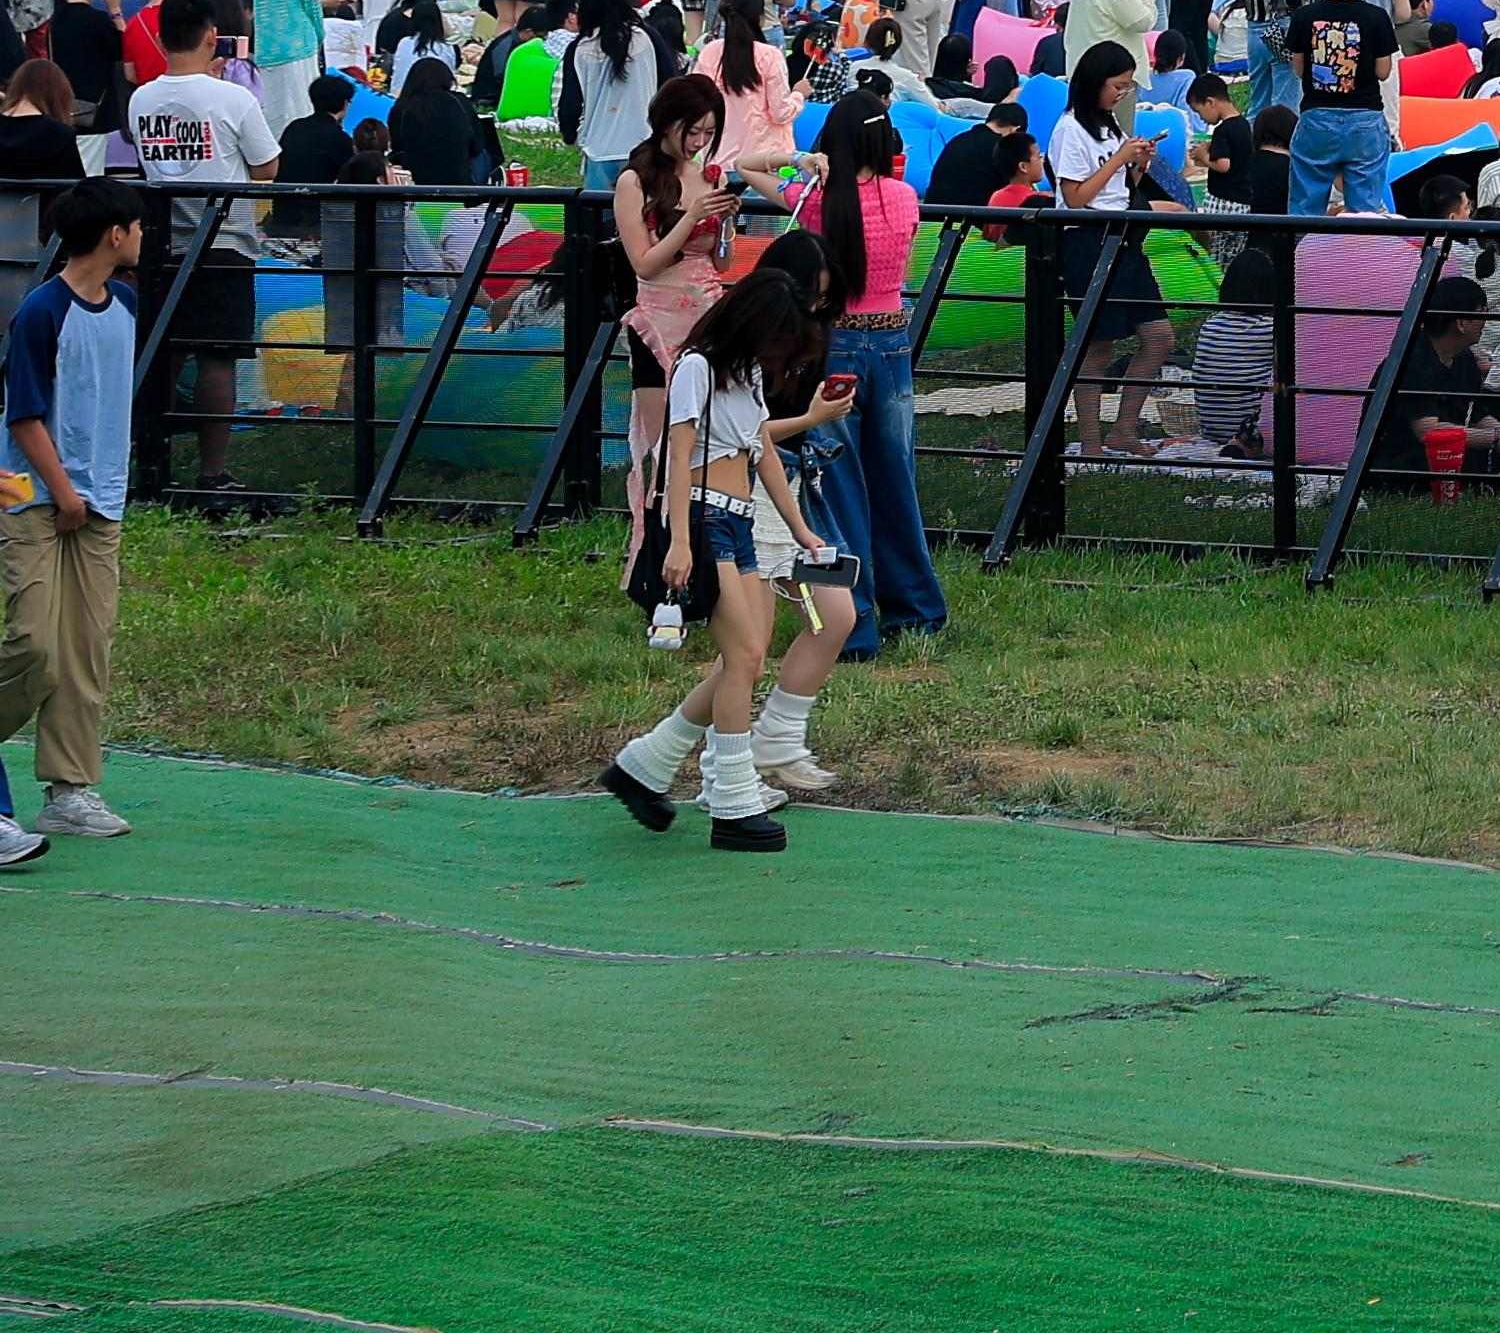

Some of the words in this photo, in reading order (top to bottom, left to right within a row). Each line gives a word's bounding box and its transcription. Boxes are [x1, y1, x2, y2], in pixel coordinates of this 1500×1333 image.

[138, 115, 172, 139] PLAY
[175, 121, 204, 144] COOL
[141, 144, 204, 162] EARTH
